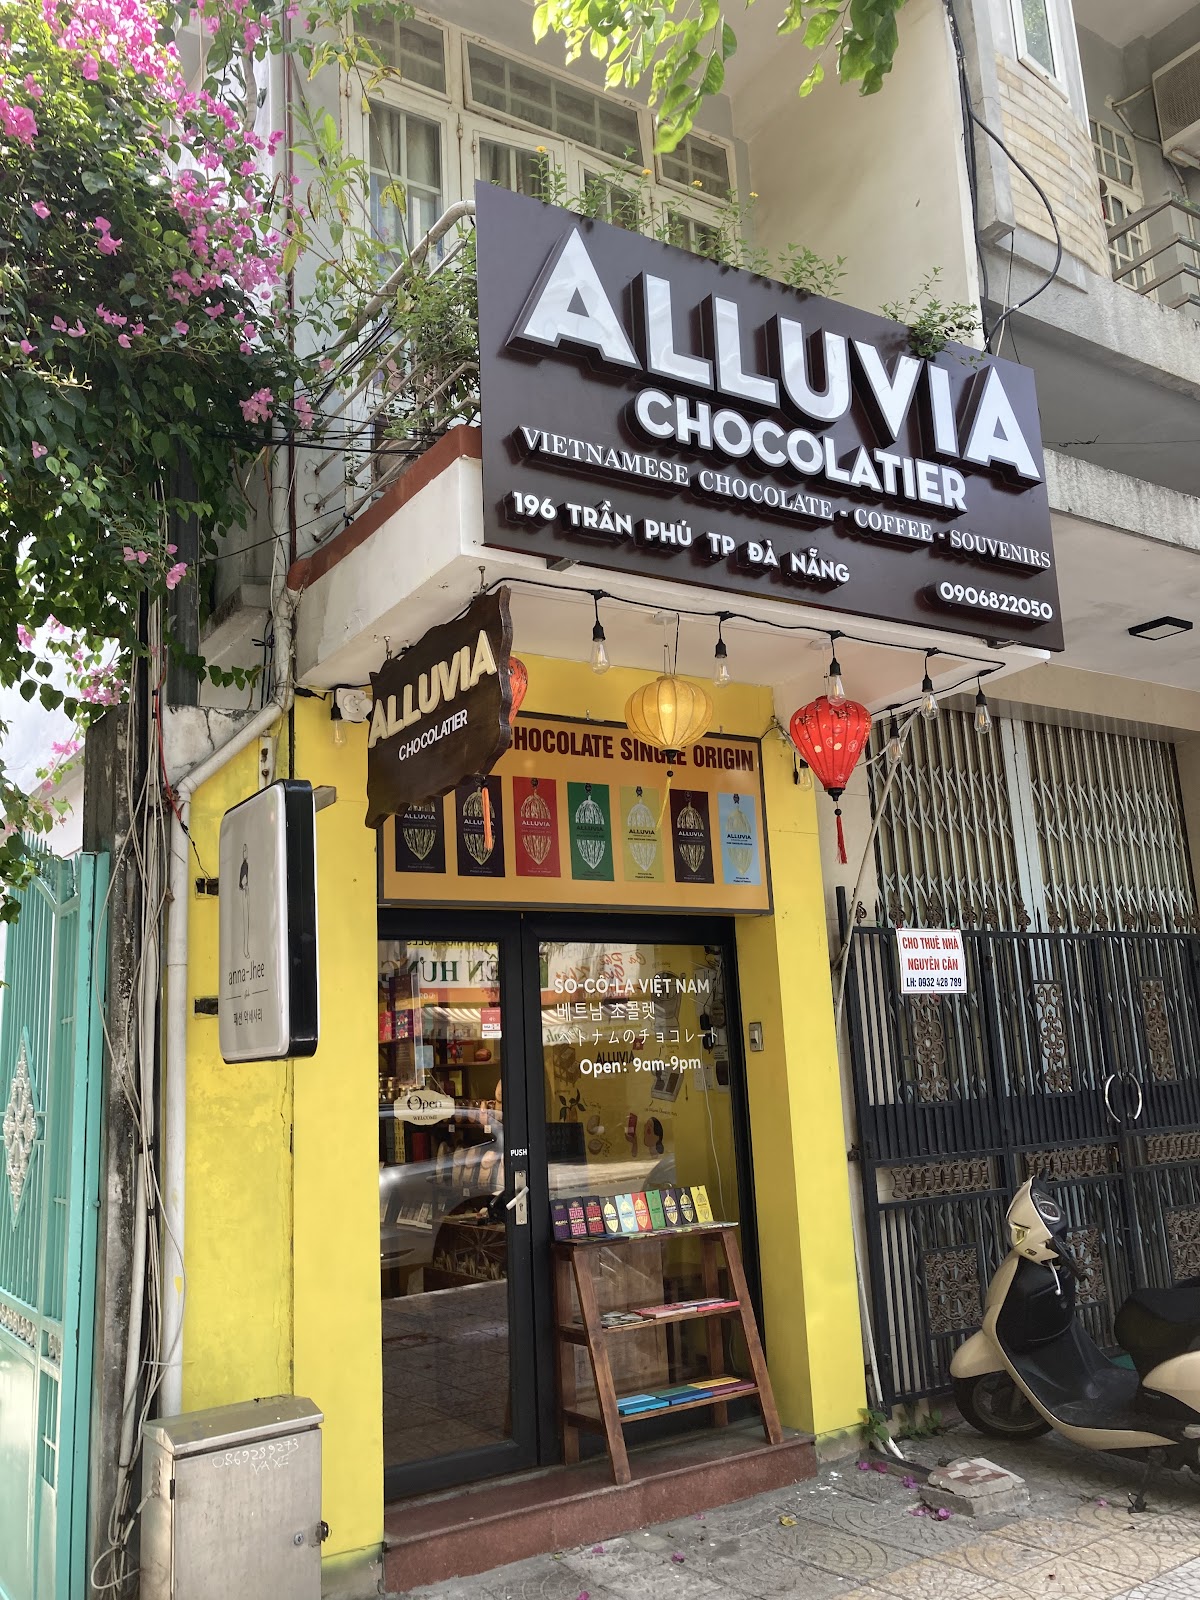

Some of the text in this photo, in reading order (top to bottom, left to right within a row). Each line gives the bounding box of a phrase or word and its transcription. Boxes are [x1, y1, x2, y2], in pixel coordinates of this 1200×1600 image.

[516, 226, 1042, 486] ALLUVIA
[634, 388, 967, 512] CHOCOLATIER
[520, 426, 689, 486] VIETNAMESE
[699, 469, 834, 521] CHOCOLATE
[853, 507, 933, 541] COFFEE
[950, 529, 1052, 568] SOUVENIRS
[513, 491, 850, 583] 196 TRẦN PHÚ TP ĐÀ NẴNG
[939, 581, 1053, 621] 0906822050
[368, 629, 498, 749] ALLUVIA
[398, 709, 468, 761] CHOCOLATIER
[620, 737, 687, 766] SINGE
[693, 745, 754, 772] ORIGIN
[463, 818, 495, 827] ALLUA
[678, 830, 704, 838] ALLUVIA
[902, 935, 959, 950] CHO THUÊ NHÀ
[228, 960, 265, 986] anna-Jhee
[907, 956, 959, 971] NGUYÊN CĂN
[554, 974, 710, 998] SO-CÔ-LA VIỆT NAM
[906, 977, 917, 988] LH:
[918, 977, 935, 987] 0932
[949, 977, 962, 987] 789
[556, 1001, 656, 1022] 베트남 초콜렛
[579, 1055, 702, 1078] Open: 9am-9pm
[596, 1050, 635, 1065] ALLUVIA
[407, 1095, 443, 1113] Open
[510, 1148, 528, 1157] PUSH
[212, 1438, 299, 1469] 0869289273
